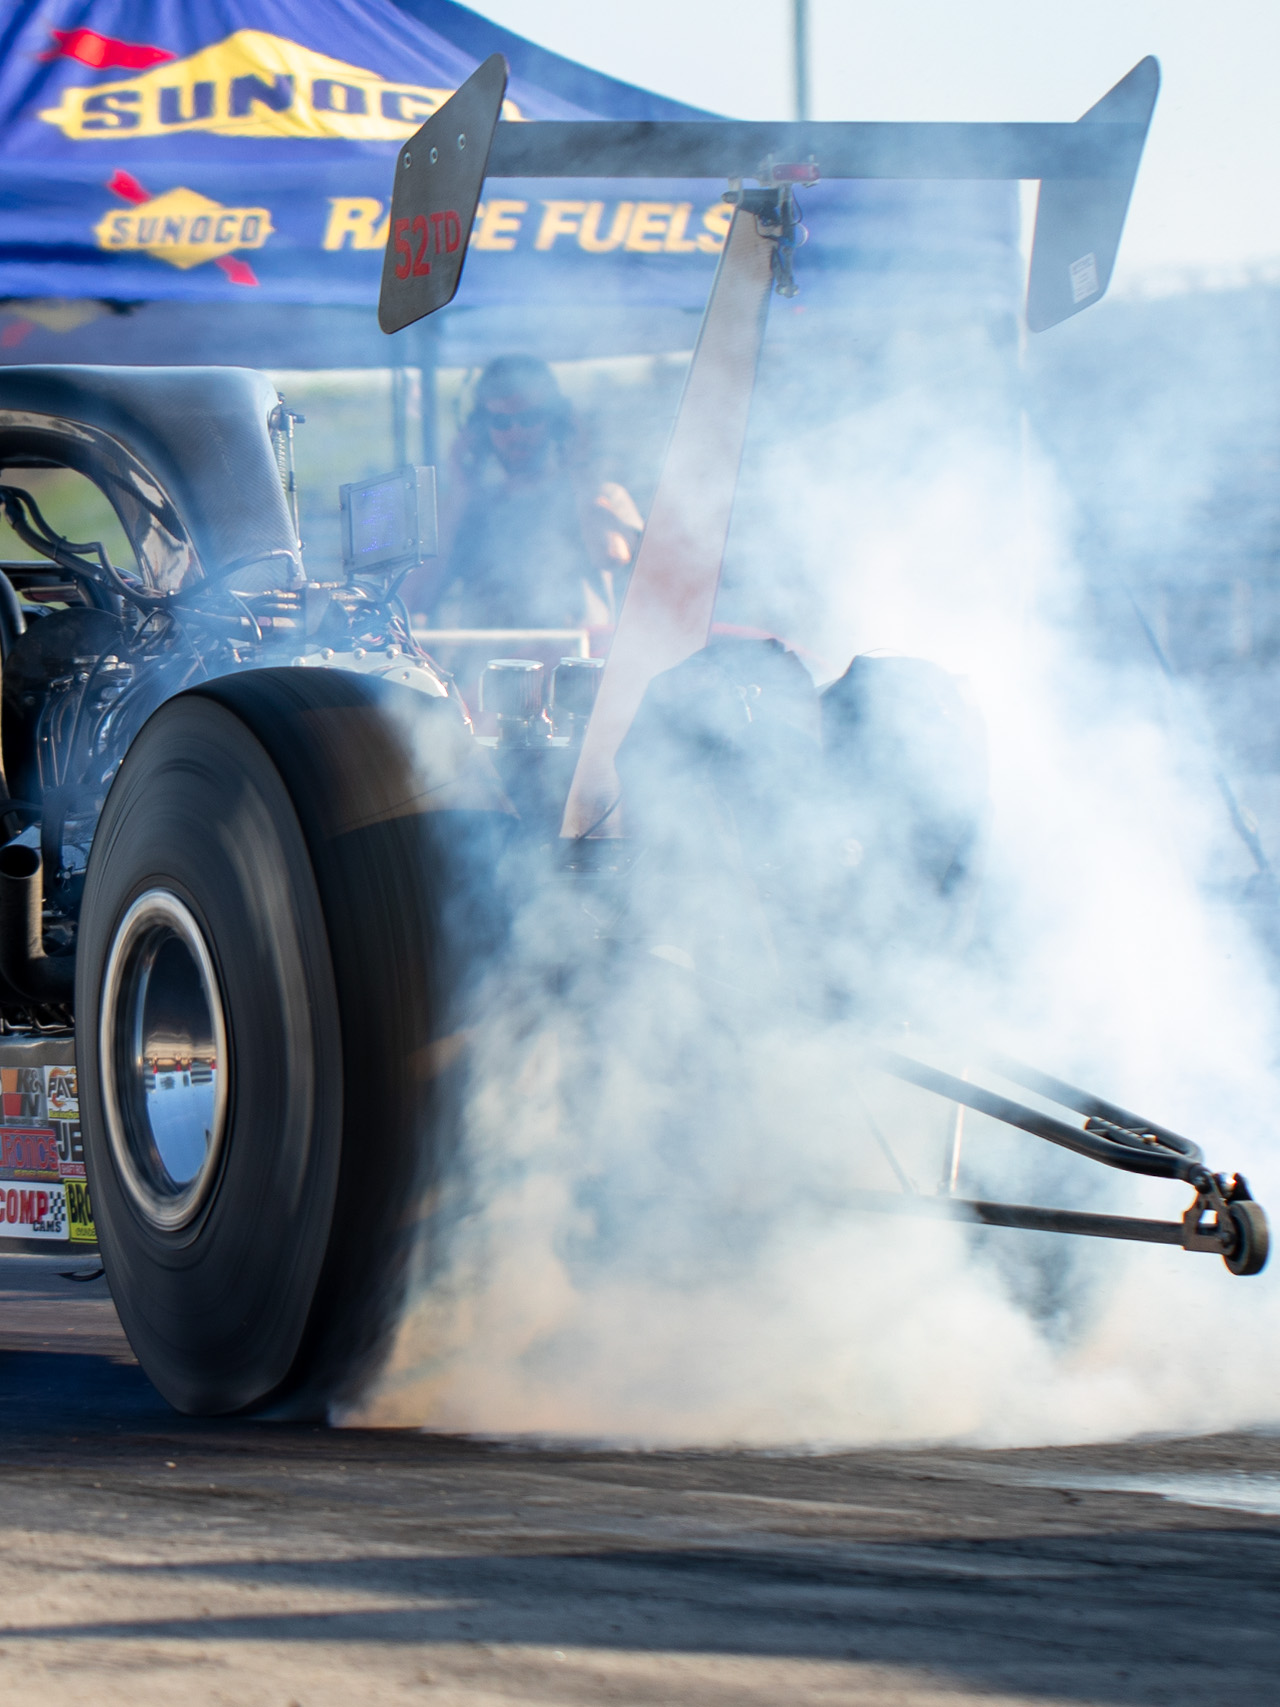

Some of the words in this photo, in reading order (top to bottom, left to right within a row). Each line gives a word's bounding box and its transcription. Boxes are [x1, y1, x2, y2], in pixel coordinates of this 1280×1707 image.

[82, 74, 435, 131] SUNOC
[110, 214, 261, 246] SUNOCO
[394, 210, 461, 279] 52TD
[534, 200, 734, 252] FUELS
[32, 1220, 62, 1232] CAMS
